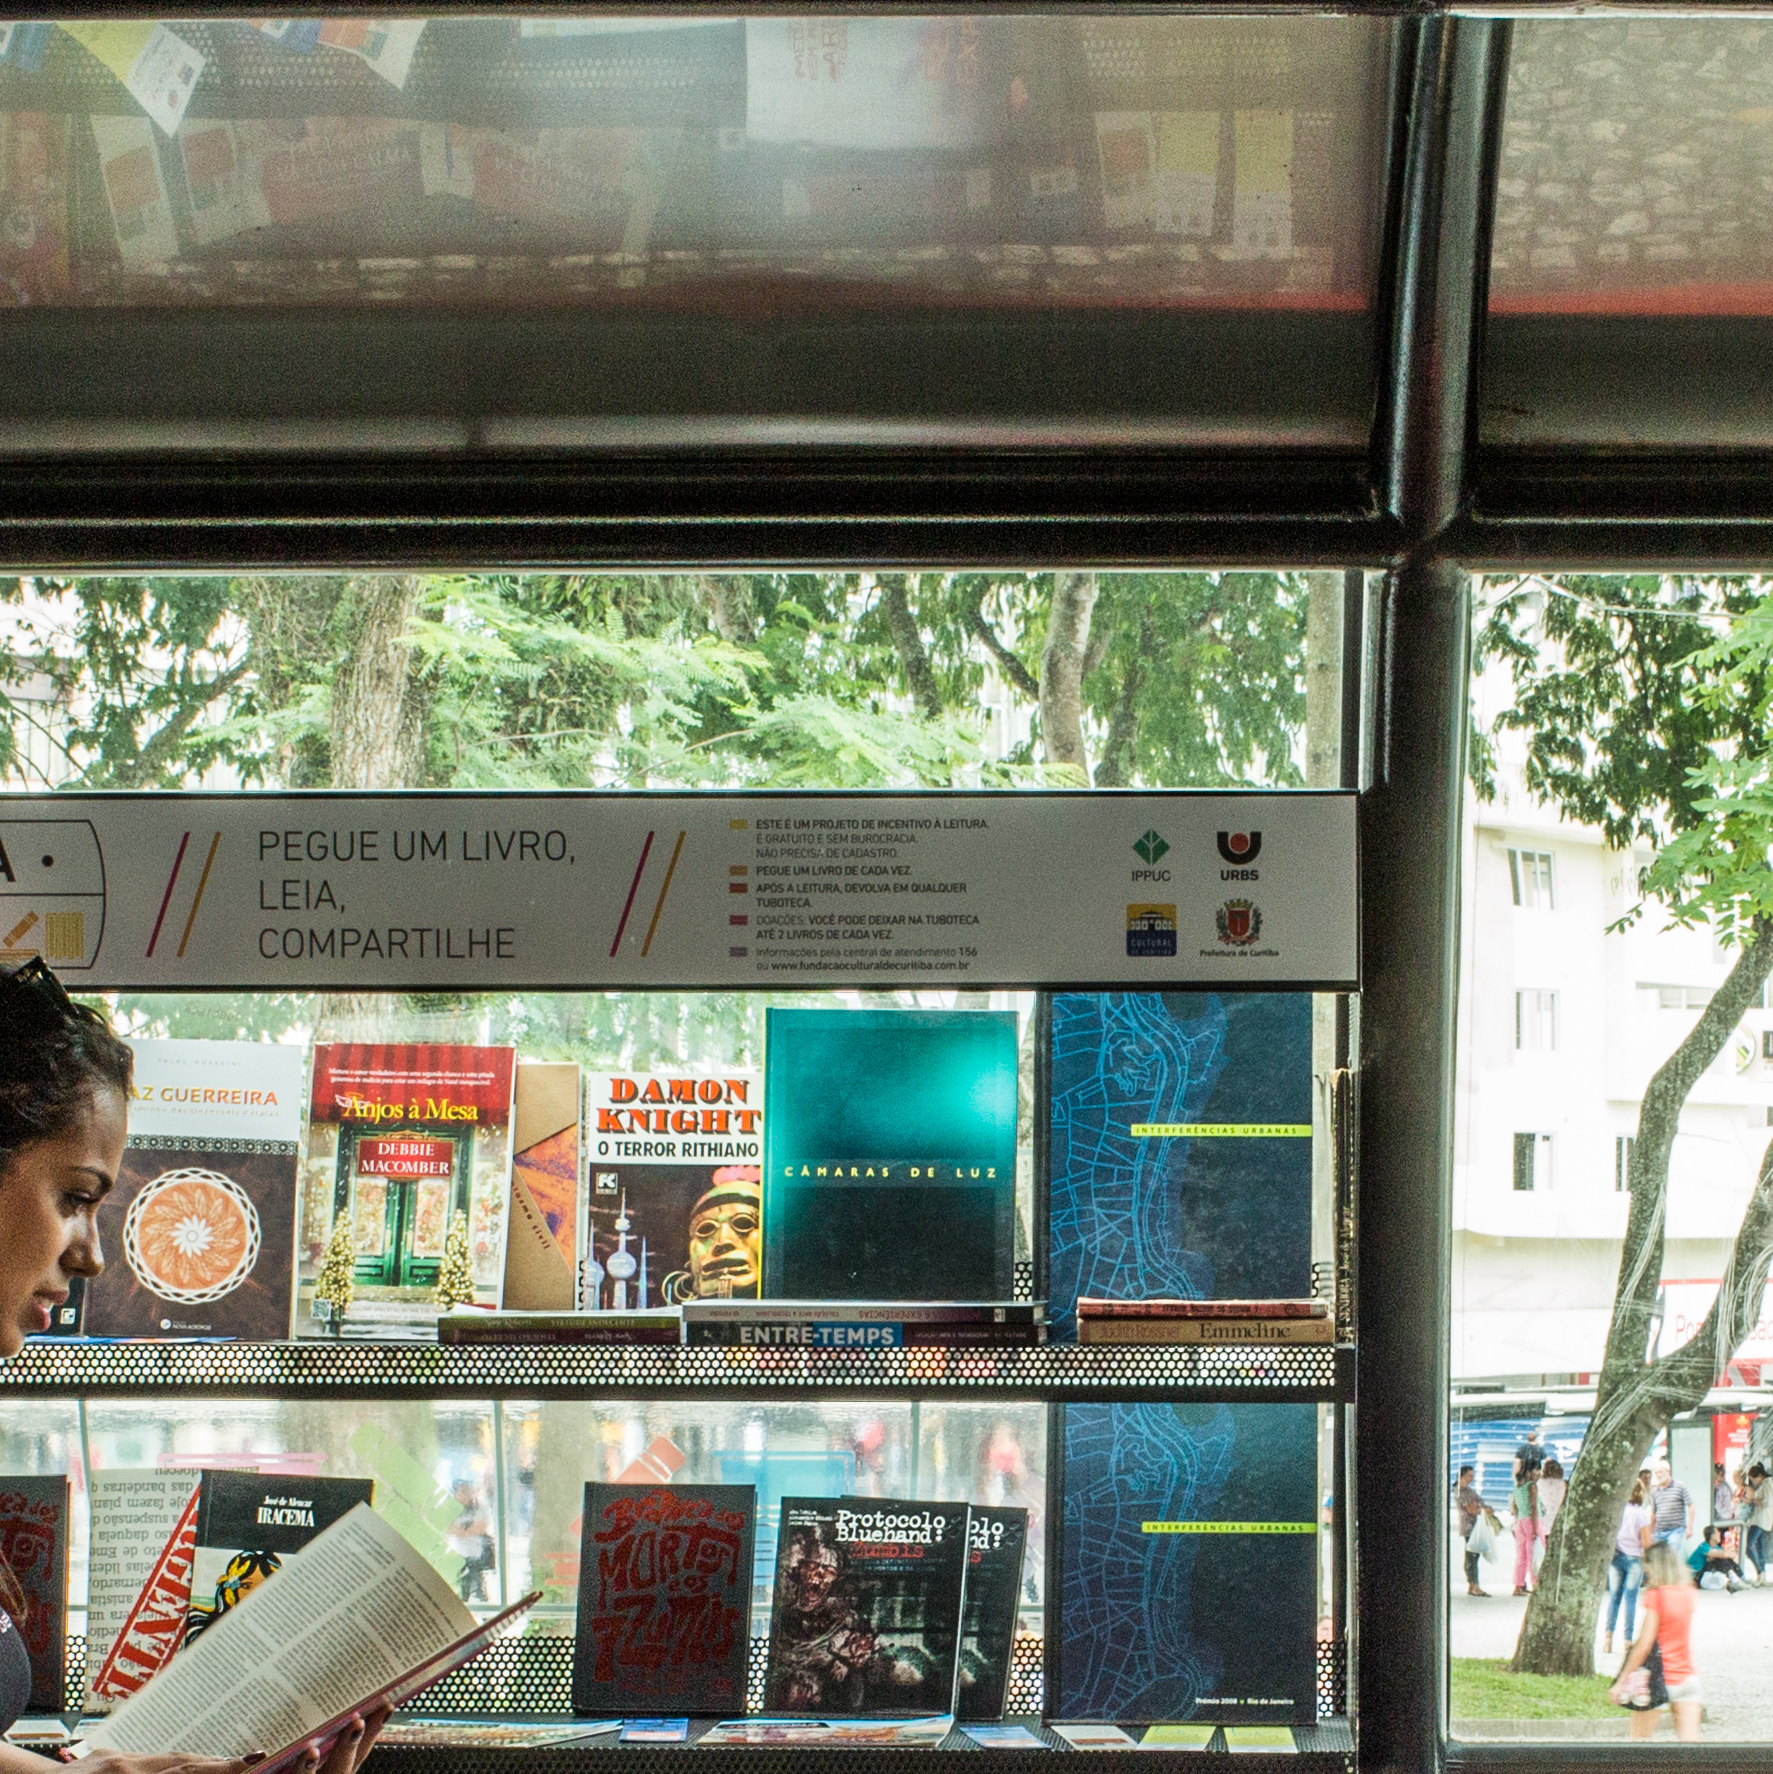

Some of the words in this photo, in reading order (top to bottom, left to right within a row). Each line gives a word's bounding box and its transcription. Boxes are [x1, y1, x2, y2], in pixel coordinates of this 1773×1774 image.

[755, 819, 783, 830] ESTE
[793, 819, 811, 830] UM
[813, 819, 859, 830] PROJETO
[861, 819, 875, 830] DE
[878, 819, 931, 830] INCENTIVO
[944, 819, 990, 830] LEITURA.
[765, 832, 814, 844] GRATUITO
[817, 832, 823, 844] E
[826, 832, 848, 844] SEM
[851, 832, 918, 844] BUROCRACIA.
[259, 831, 380, 862] PEGUE
[393, 831, 455, 861] UM
[462, 831, 576, 866] LIVRO,
[756, 847, 777, 859] NÃO
[780, 847, 823, 859] PRECISA
[826, 847, 840, 859] DE
[756, 865, 791, 876] PEGUE
[793, 865, 810, 876] UM
[812, 865, 843, 876] LIVRO
[845, 865, 858, 876] DE
[860, 865, 888, 876] CADA
[891, 865, 912, 876] VEZ.
[1131, 870, 1171, 882] IPPUC
[1220, 869, 1259, 881] URBS
[756, 882, 784, 894] APÓS
[787, 882, 794, 894] A
[796, 882, 843, 894] LEITURA,
[845, 882, 891, 894] DEVOLVA
[893, 882, 908, 894] EM
[911, 882, 966, 894] QUALQUER
[259, 880, 347, 915] LEIA,
[809, 915, 836, 926] VOCÊ
[838, 915, 866, 926] PODE
[868, 915, 905, 926] DEIXAR
[908, 915, 922, 926] NA
[925, 915, 979, 926] TUBOTECA
[756, 929, 775, 940] ATÉ
[778, 929, 784, 940] 2
[787, 929, 823, 940] LIVROS
[826, 929, 840, 940] DE
[842, 929, 870, 940] CADA
[872, 929, 894, 940] VEZ.
[259, 928, 515, 960] COMPARTILHE
[819, 947, 840, 959] pela
[843, 947, 876, 959] central
[879, 947, 892, 959] de
[895, 947, 956, 959] atendimento
[958, 947, 978, 959] 156
[1199, 949, 1237, 958] Prefeitura
[127, 1085, 154, 1101] AZ
[162, 1088, 279, 1106] GUERREIRA
[609, 1077, 751, 1105] DAMON
[342, 1094, 404, 1125] Anjos
[408, 1098, 420, 1119] à
[424, 1098, 479, 1121] Mesa
[596, 1107, 762, 1136] KNIGHT
[1136, 1125, 1236, 1135] INTERFERÊNCIAS
[1243, 1127, 1297, 1135] URBANAS
[378, 1142, 435, 1156] DEBBIE
[597, 1141, 609, 1156] O
[615, 1141, 676, 1157] TERROR
[682, 1142, 759, 1158] RITHIANO
[361, 1160, 450, 1174] MACOMBER
[784, 1164, 890, 1178] CÂMARAS
[910, 1167, 935, 1178] DE
[956, 1167, 996, 1178] LUZ
[740, 1326, 895, 1346] ENTRE-TEMPS
[1199, 1322, 1291, 1340] Emmeline
[104, 1482, 166, 1492] bandeiras
[171, 1482, 194, 1492] das
[131, 1498, 163, 1509] fazem
[170, 1499, 189, 1510] oje
[263, 1495, 279, 1505] José
[289, 1498, 313, 1508] Alencar
[104, 1514, 168, 1525] suspensão
[257, 1507, 315, 1527] IRACEMA
[837, 1509, 946, 1529] Protocolo
[1146, 1523, 1245, 1532] INTERFERÊNCIAS
[99, 1530, 149, 1541] daquela
[835, 1526, 942, 1544] Bluehand:
[124, 1546, 136, 1556] de
[851, 1542, 924, 1559] Zumbis
[91, 1594, 133, 1604] anistia
